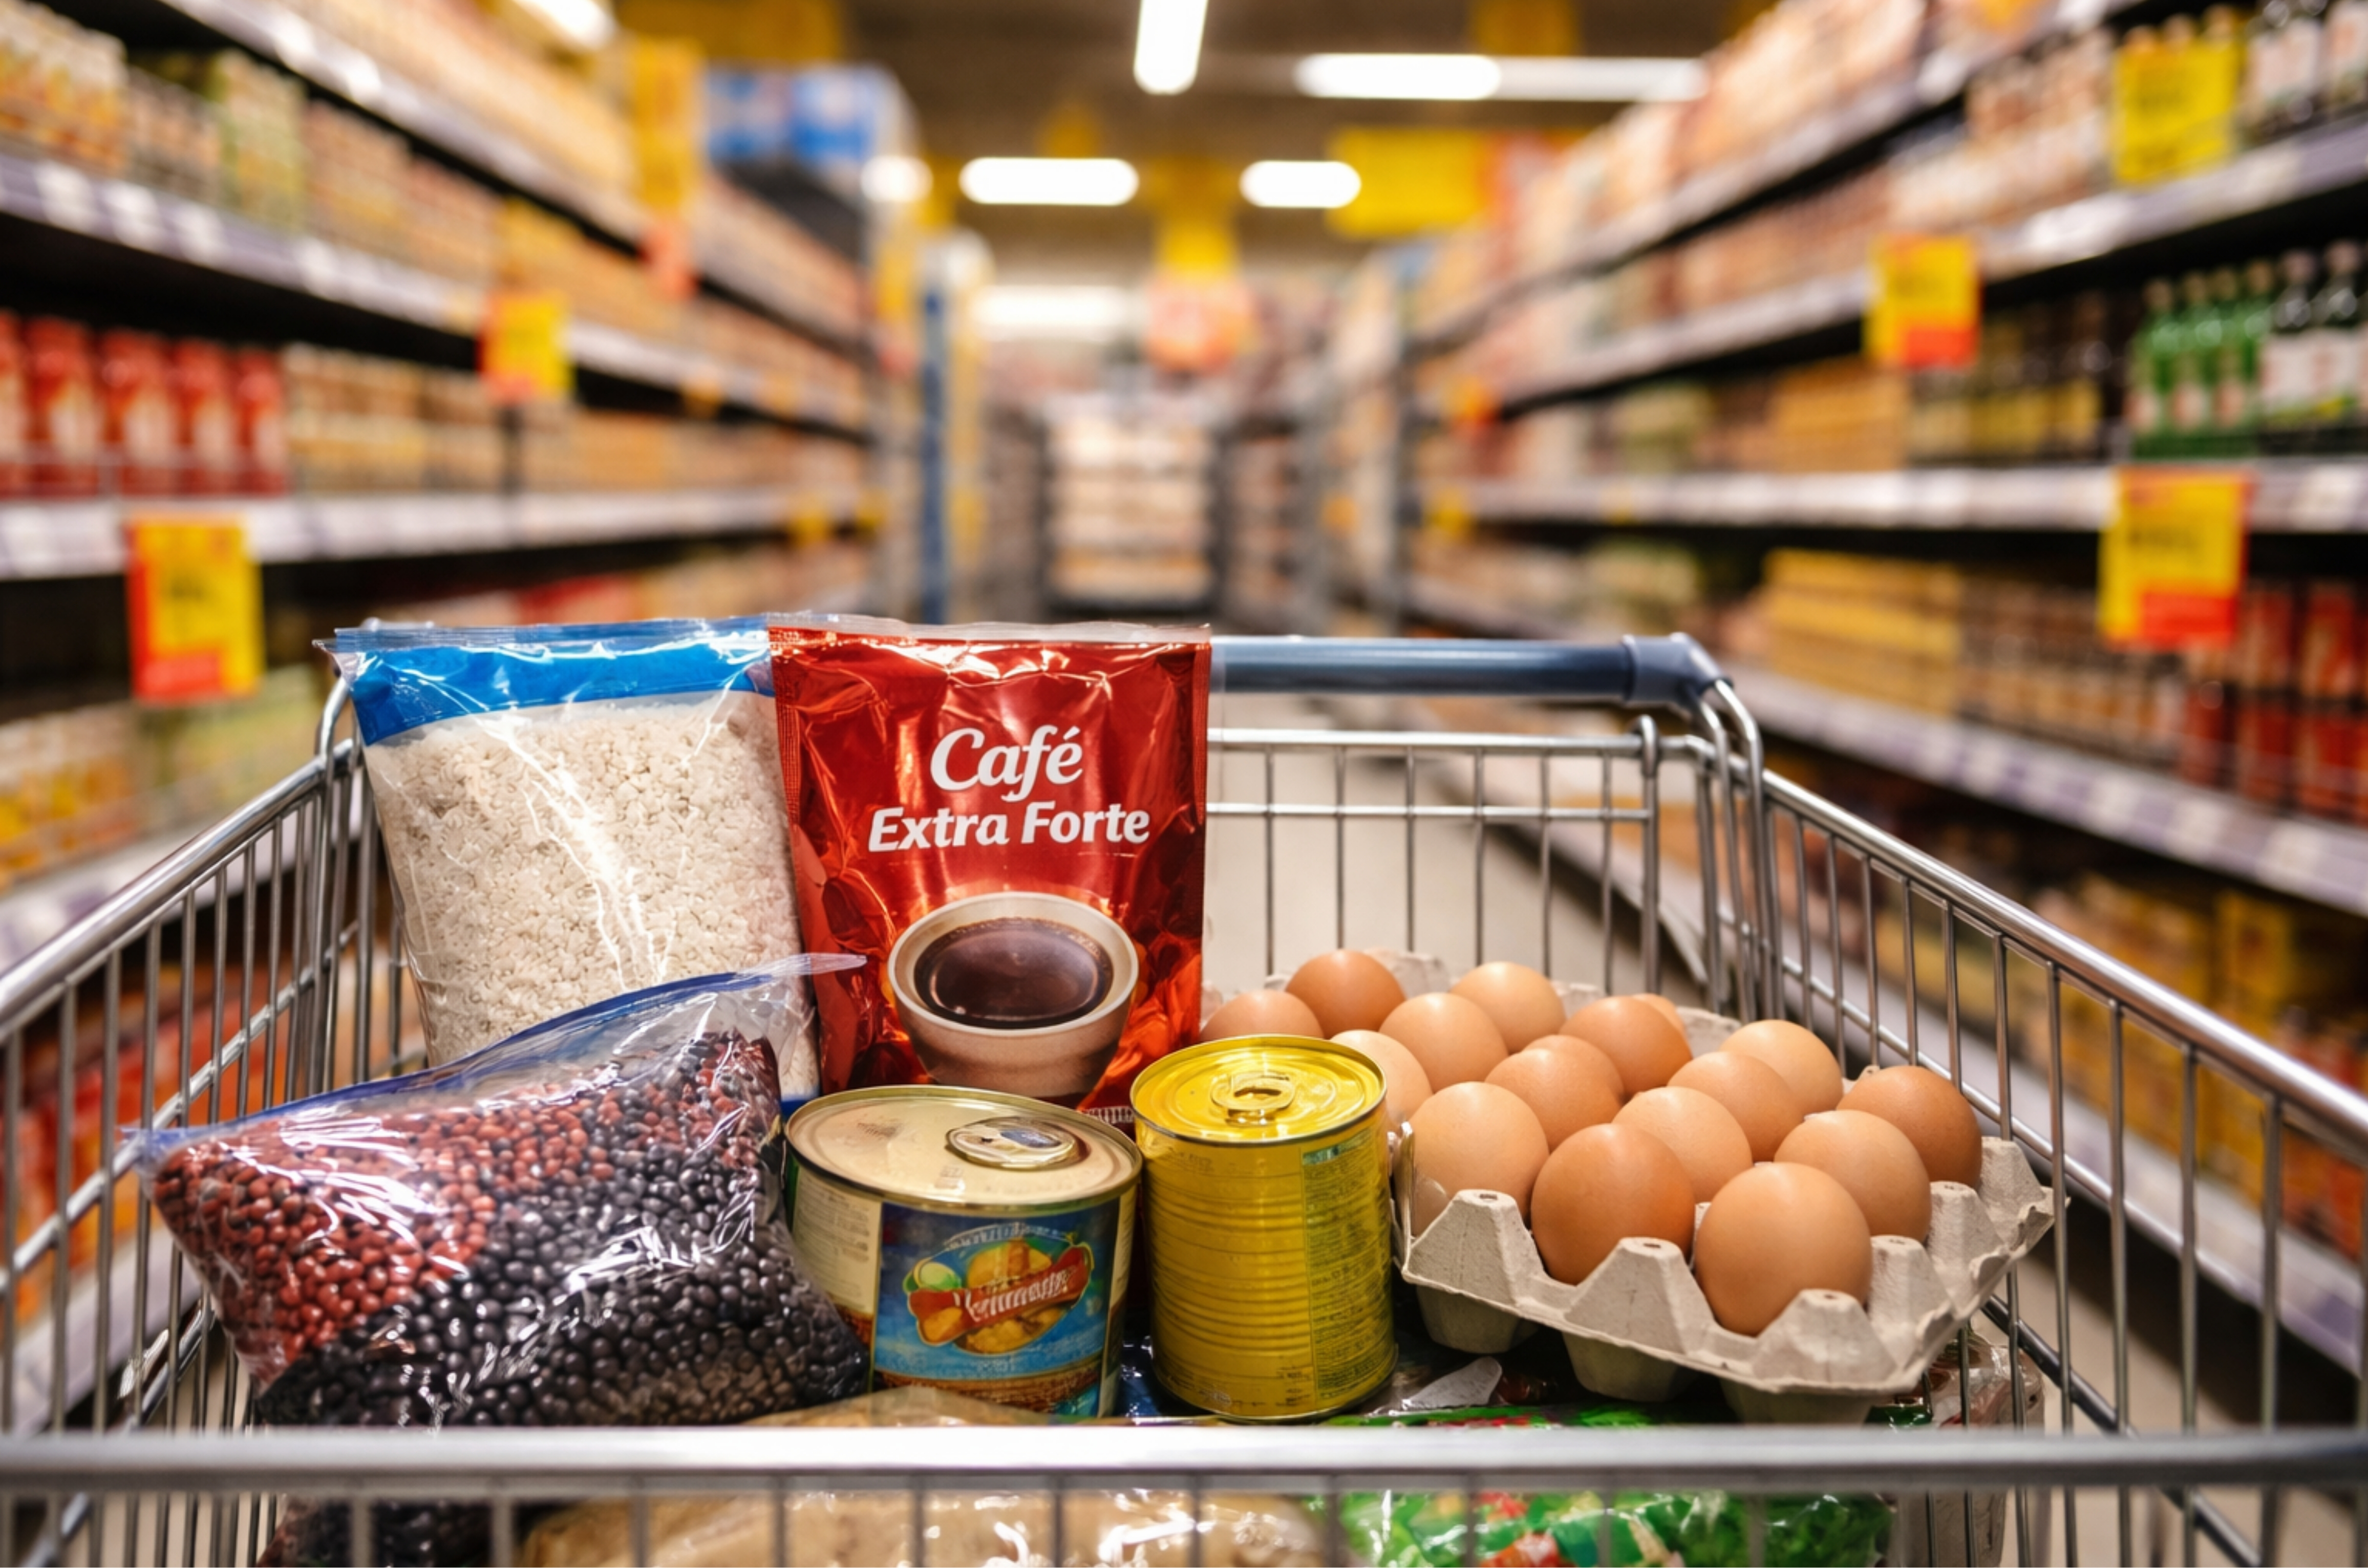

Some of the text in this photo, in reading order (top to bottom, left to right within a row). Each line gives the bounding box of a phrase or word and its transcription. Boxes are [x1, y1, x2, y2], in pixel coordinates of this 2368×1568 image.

[930, 725, 1083, 802] Café
[868, 801, 1150, 852] Extra Forte
